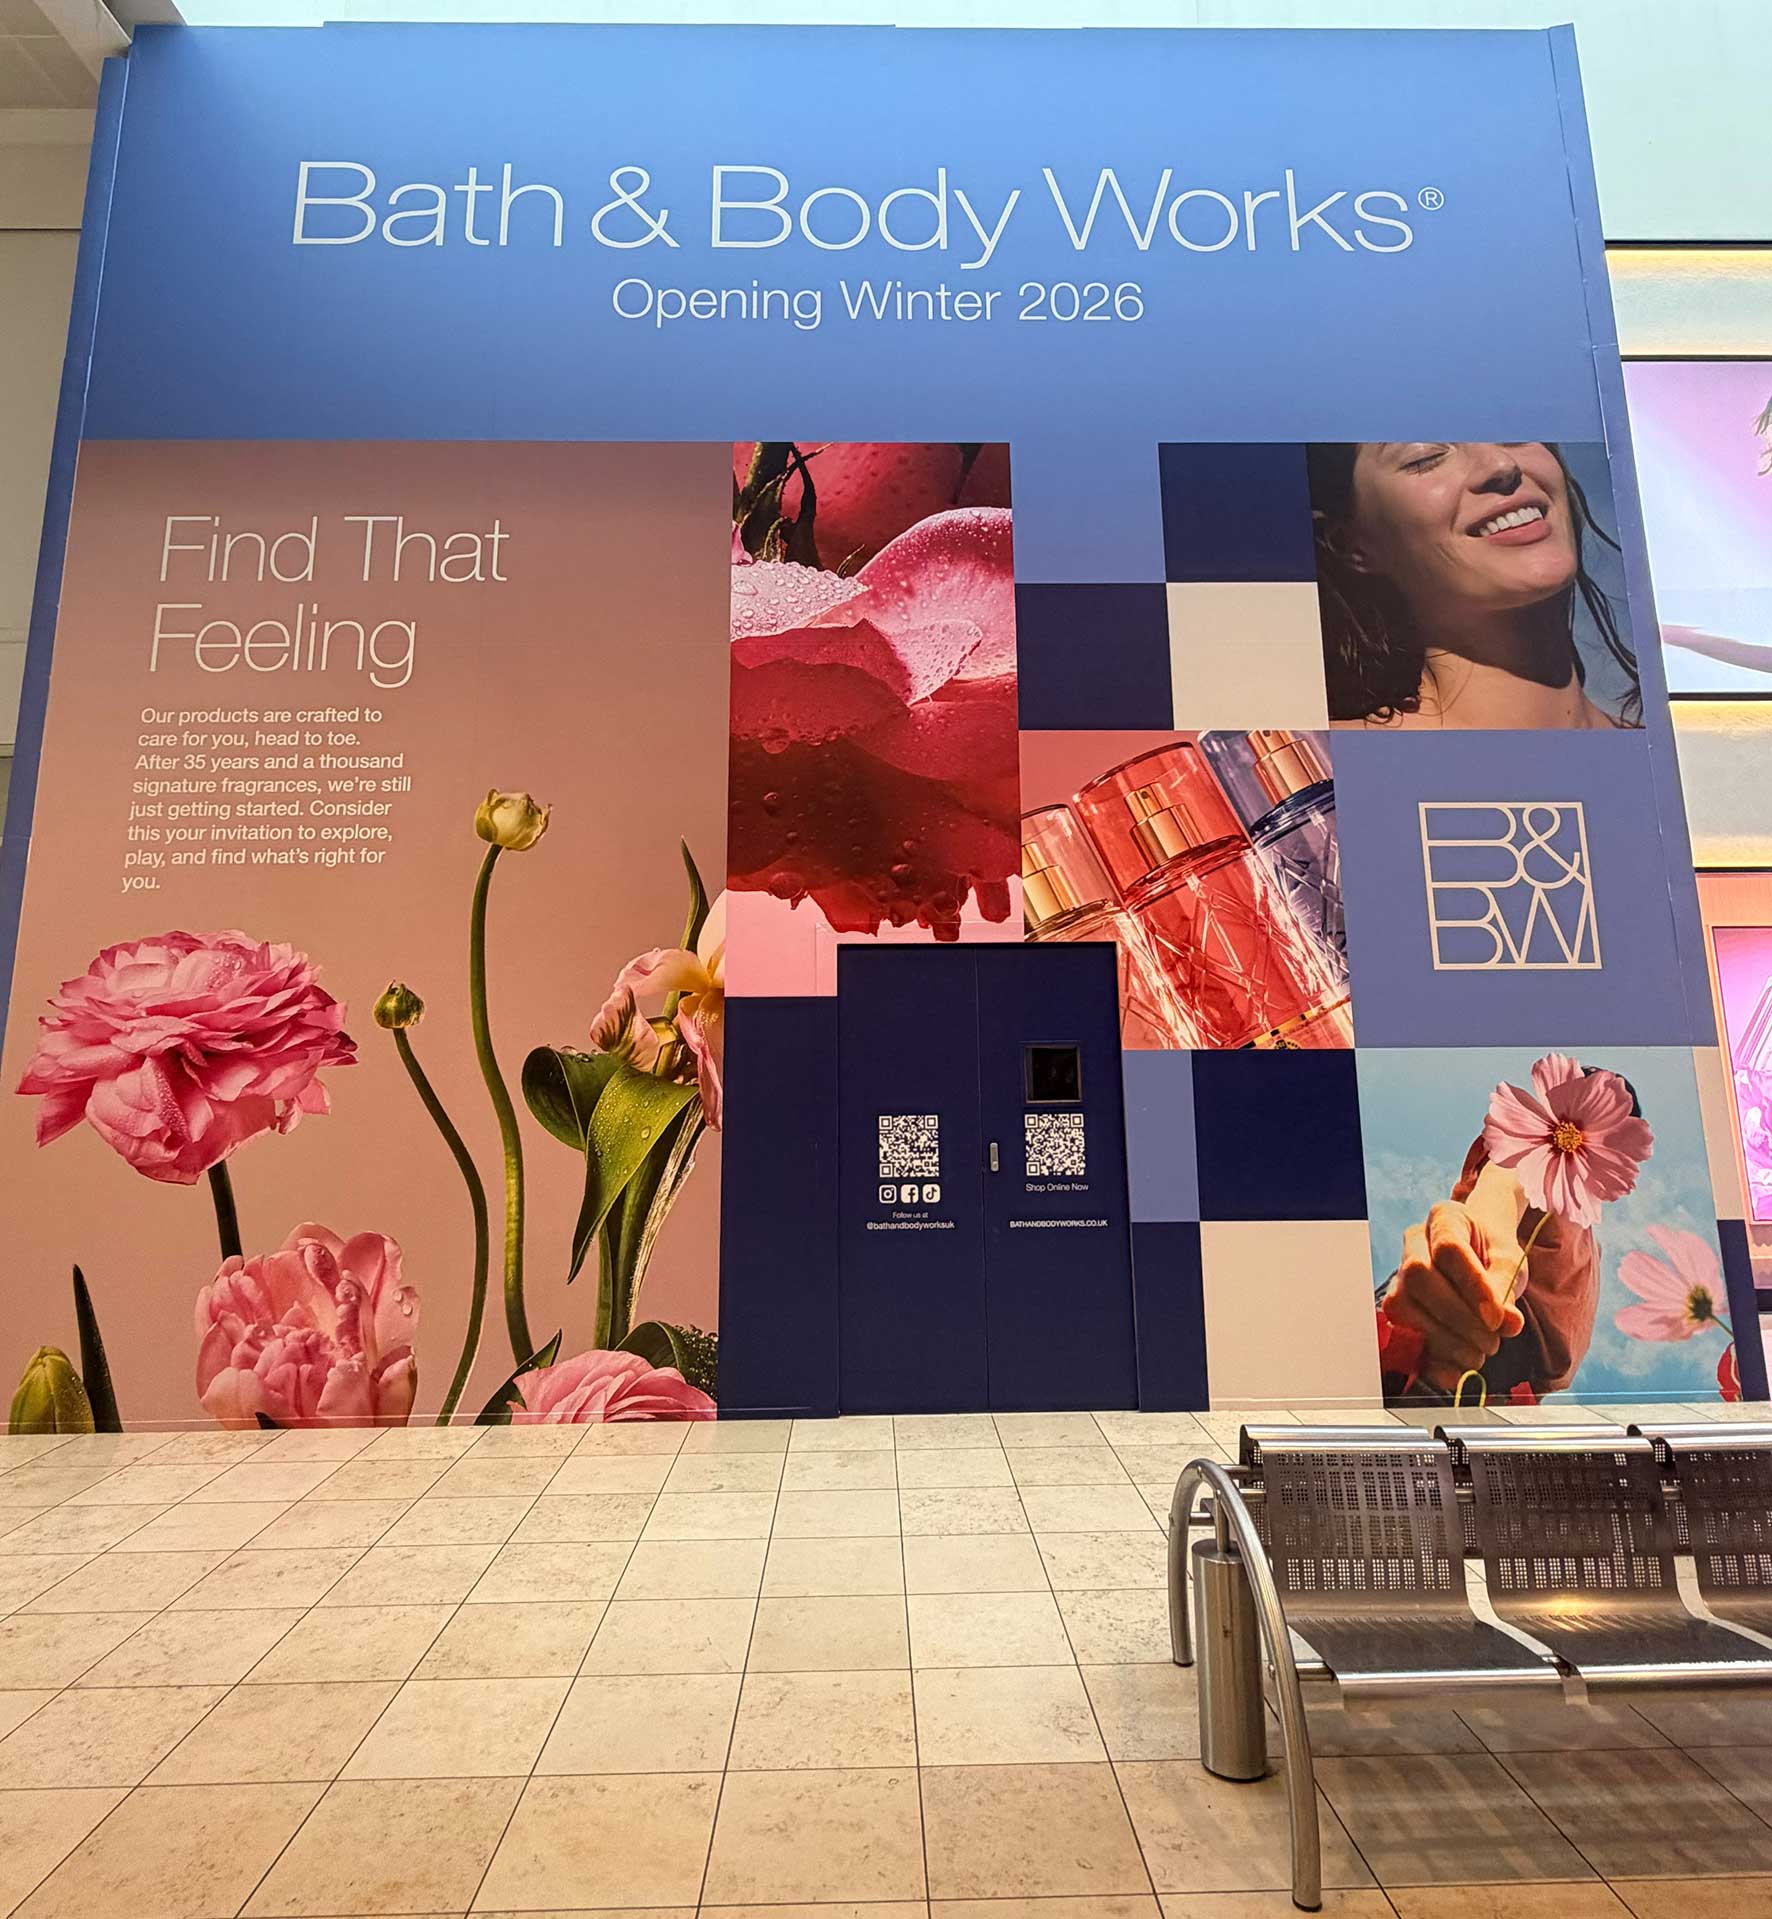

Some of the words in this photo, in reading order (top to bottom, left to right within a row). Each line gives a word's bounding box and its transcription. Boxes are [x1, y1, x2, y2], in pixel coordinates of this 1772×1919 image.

[293, 161, 563, 247] Bath
[591, 166, 680, 249] &
[711, 165, 1021, 270] Body
[612, 278, 823, 331] Opening
[840, 279, 1002, 321] Winter
[1018, 280, 1145, 322] 2026
[160, 516, 318, 583] Find
[344, 516, 510, 583] That
[150, 604, 417, 689] Feeling
[141, 708, 175, 723] Our
[178, 708, 259, 726] products
[263, 711, 291, 723] are
[296, 707, 359, 723] crafted
[364, 709, 382, 723] to
[138, 735, 177, 747] care
[183, 731, 208, 746] for
[211, 735, 249, 749] you,
[255, 731, 299, 746] head
[304, 732, 322, 746] to
[327, 732, 360, 746] toe.
[135, 754, 180, 770] After
[184, 755, 206, 769] 35
[210, 758, 259, 773] years
[264, 754, 298, 769] and
[303, 757, 314, 769] a
[319, 753, 403, 769] thousand
[132, 778, 217, 797] signature
[221, 778, 322, 797] fragrances,
[381, 776, 411, 792] still
[128, 801, 163, 819] just
[167, 801, 231, 820] getting
[236, 801, 304, 817] started.
[309, 800, 392, 816] Consider
[127, 825, 161, 841] this
[165, 829, 208, 845] your
[211, 825, 292, 840] invitation
[298, 826, 315, 840] to
[320, 824, 393, 844] explore,
[124, 849, 166, 868] play,
[172, 849, 206, 865] and
[210, 848, 246, 864] find
[313, 848, 355, 868] right
[360, 848, 386, 864] for
[122, 877, 160, 893] you.
[1025, 1183, 1046, 1193] Shop
[1048, 1182, 1070, 1192] Online
[1071, 1182, 1089, 1192] Now
[892, 1211, 912, 1219] Follow
[1009, 1219, 1108, 1229] BATHANDBODYWORKS.CO.UK
[866, 1220, 955, 1232] @bathandbodyworksuk
